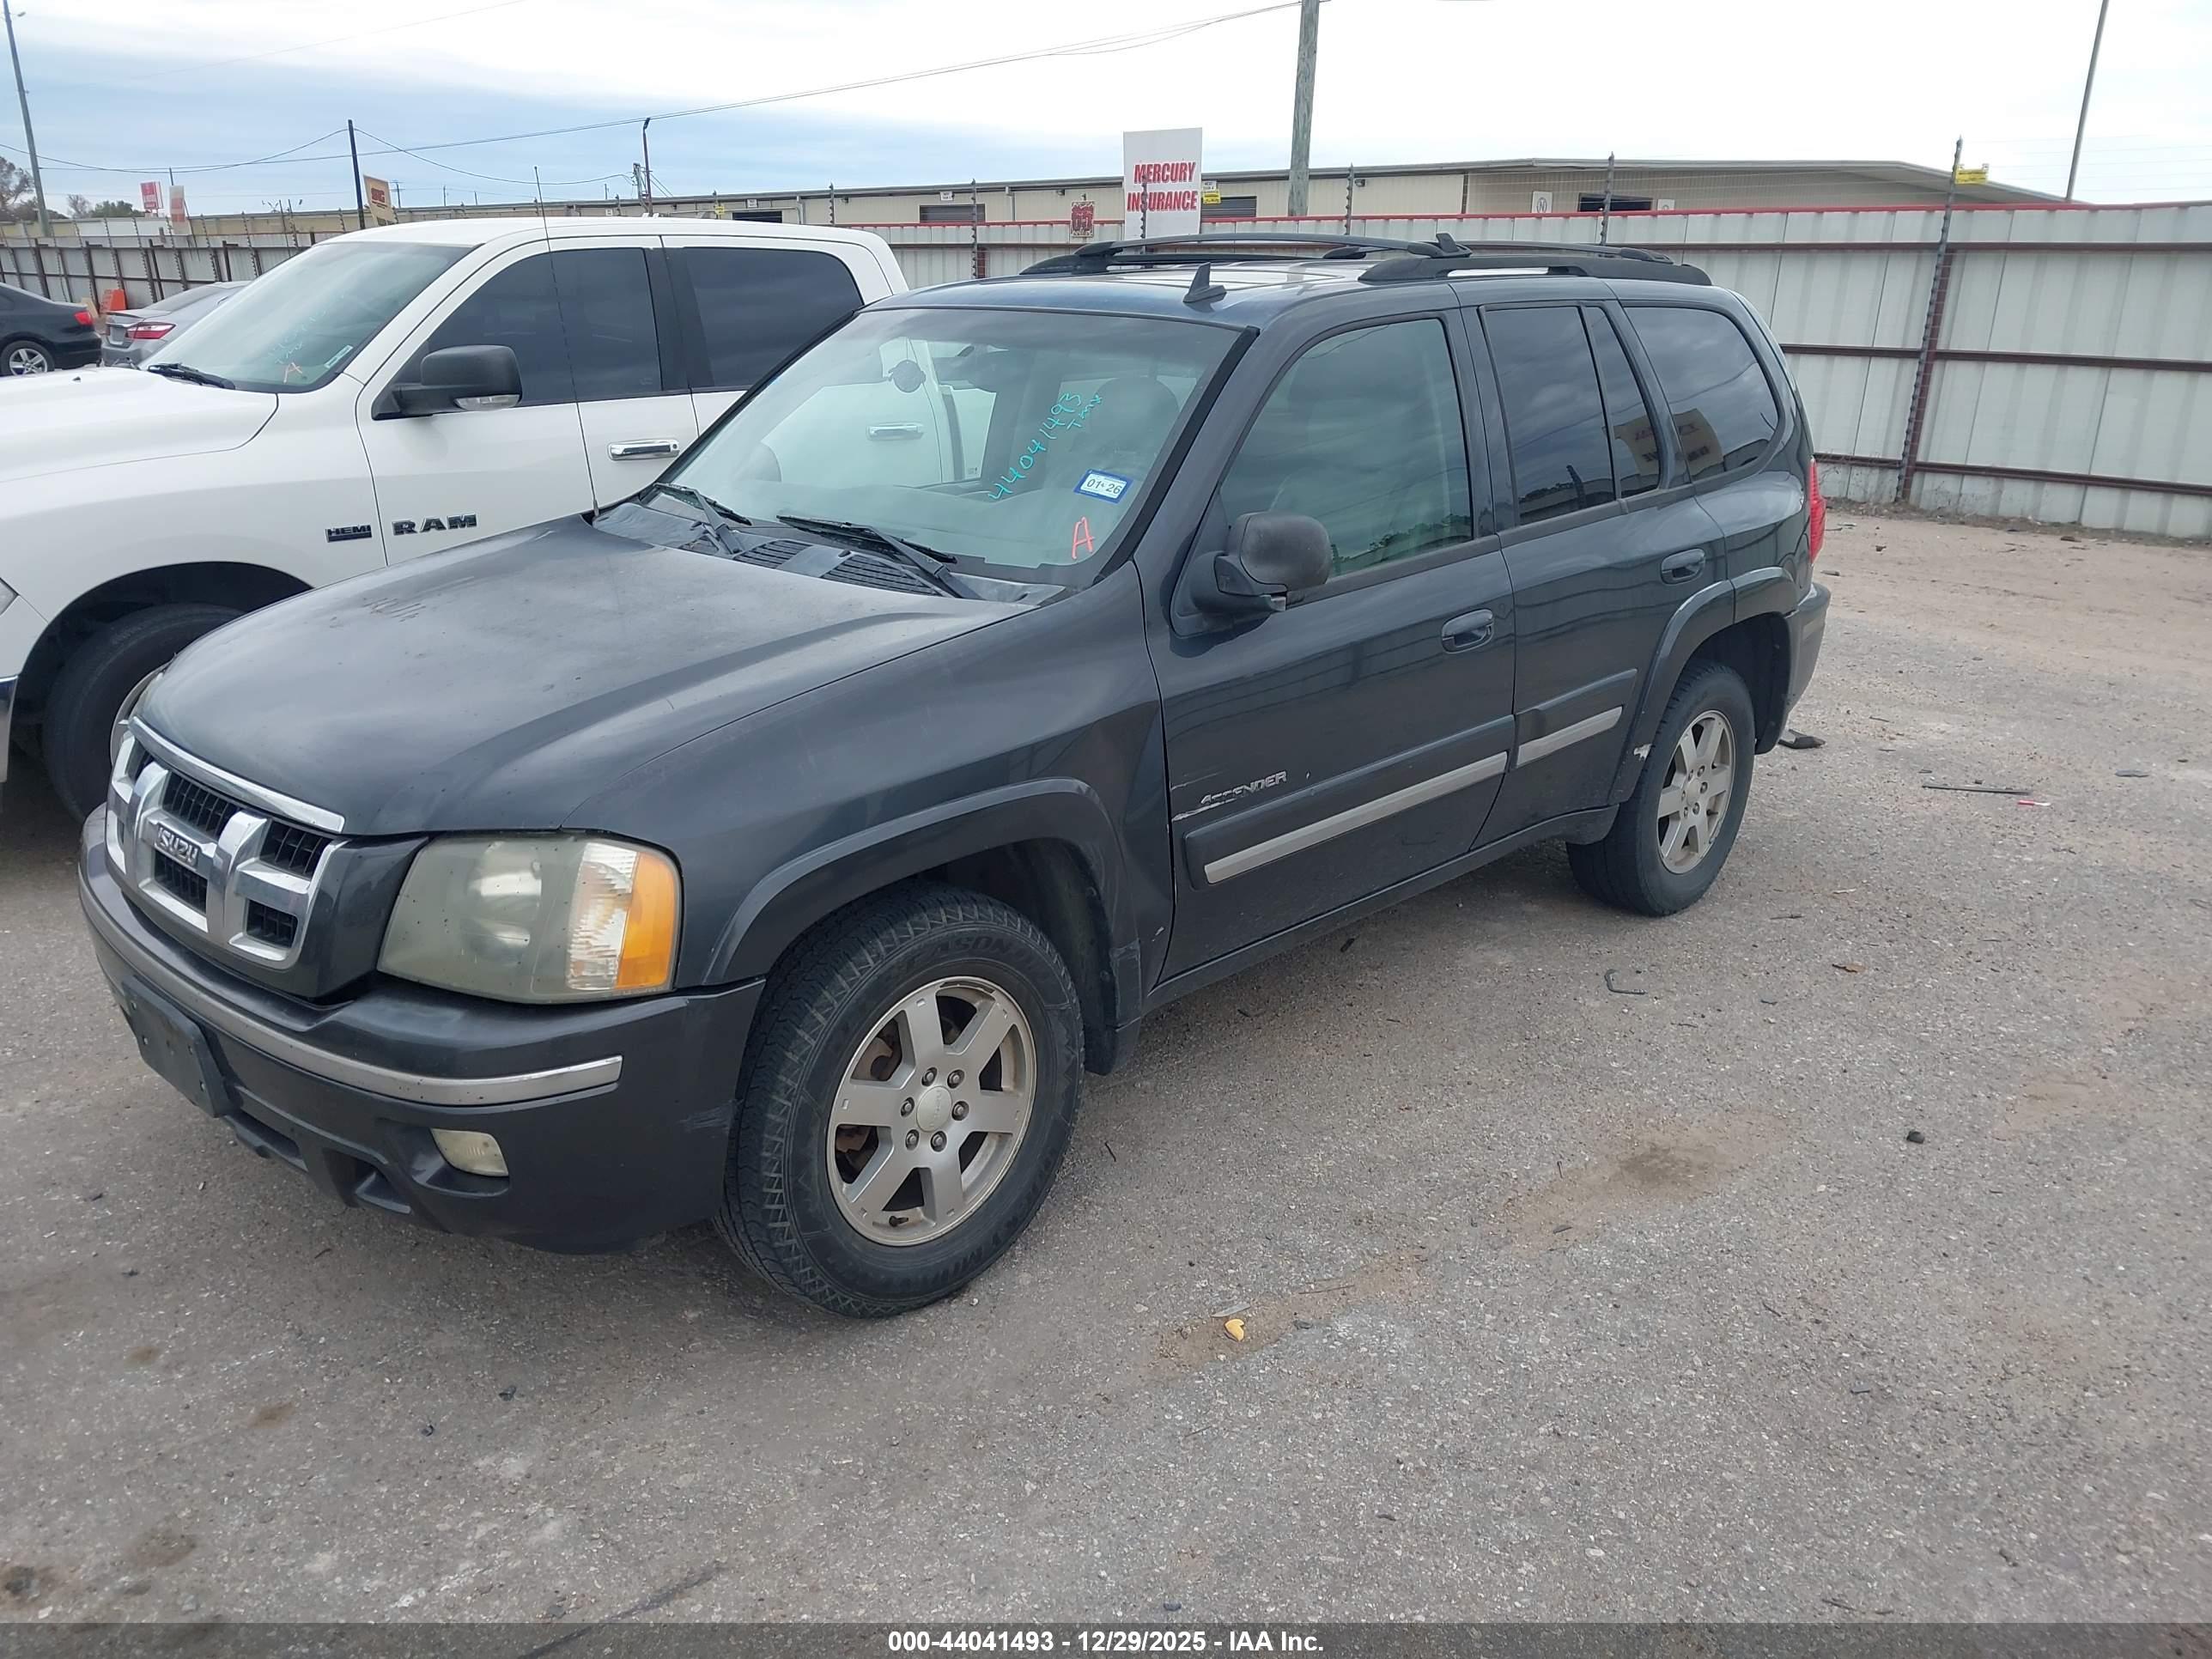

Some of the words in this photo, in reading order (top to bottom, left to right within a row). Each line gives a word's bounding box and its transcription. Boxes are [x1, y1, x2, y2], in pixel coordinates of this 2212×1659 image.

[1133, 161, 1196, 185] MERCURY
[988, 392, 1082, 500] 44041493
[1086, 478, 1103, 489] 01
[1105, 483, 1123, 495] 26
[326, 524, 372, 537] HEMI
[392, 514, 477, 536] RAM
[1072, 516, 1095, 560] A
[157, 826, 198, 863] ISUZU
